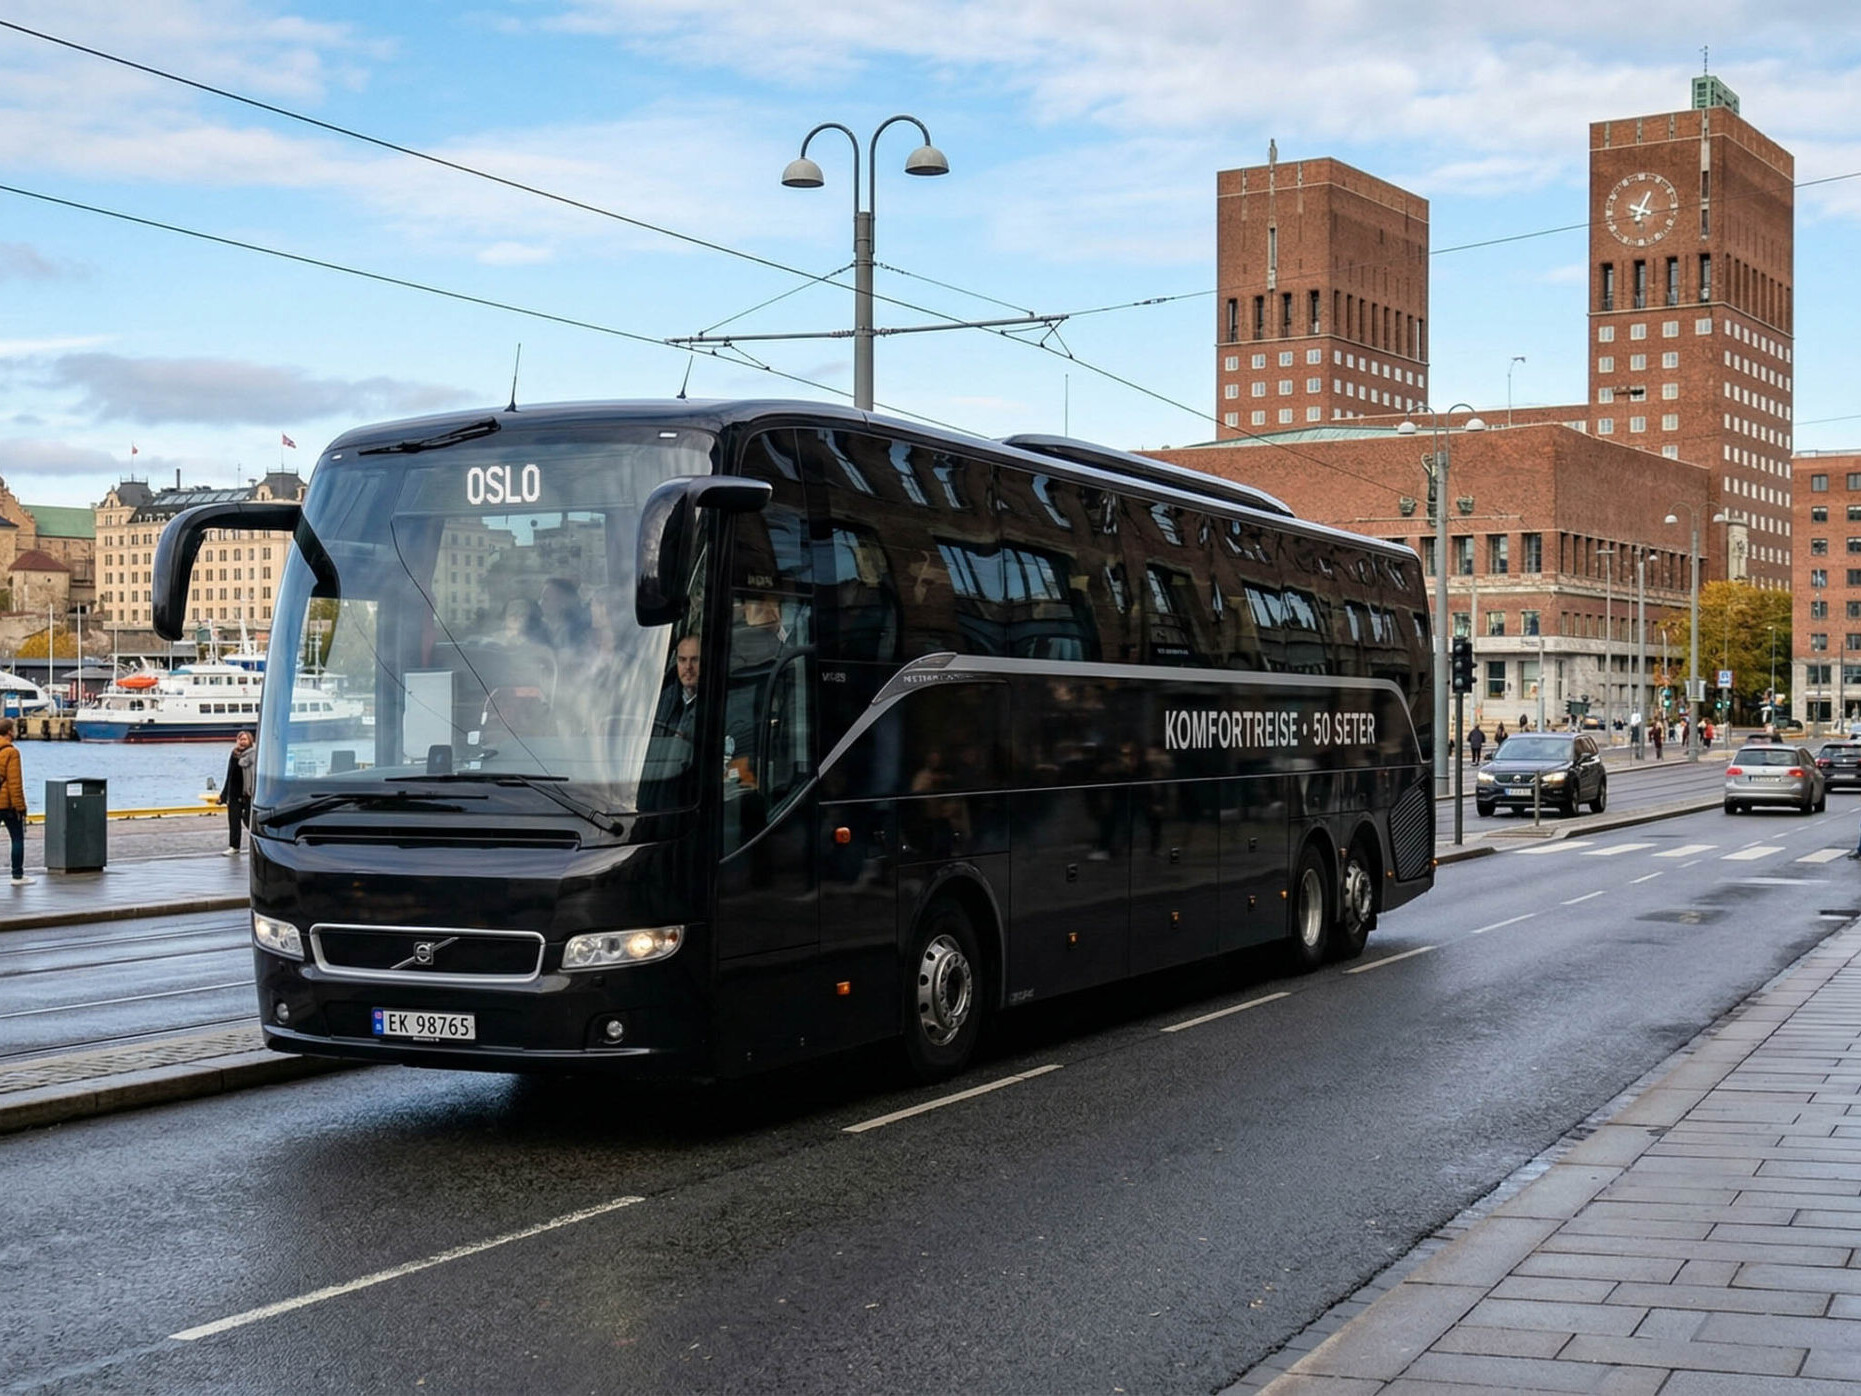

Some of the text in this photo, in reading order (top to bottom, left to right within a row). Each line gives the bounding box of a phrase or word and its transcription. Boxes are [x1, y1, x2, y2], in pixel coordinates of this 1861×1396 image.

[467, 464, 540, 505] OSLO
[1165, 710, 1375, 750] KOMFORTREISE 50 SETER
[388, 1013, 469, 1037] EK 98765
